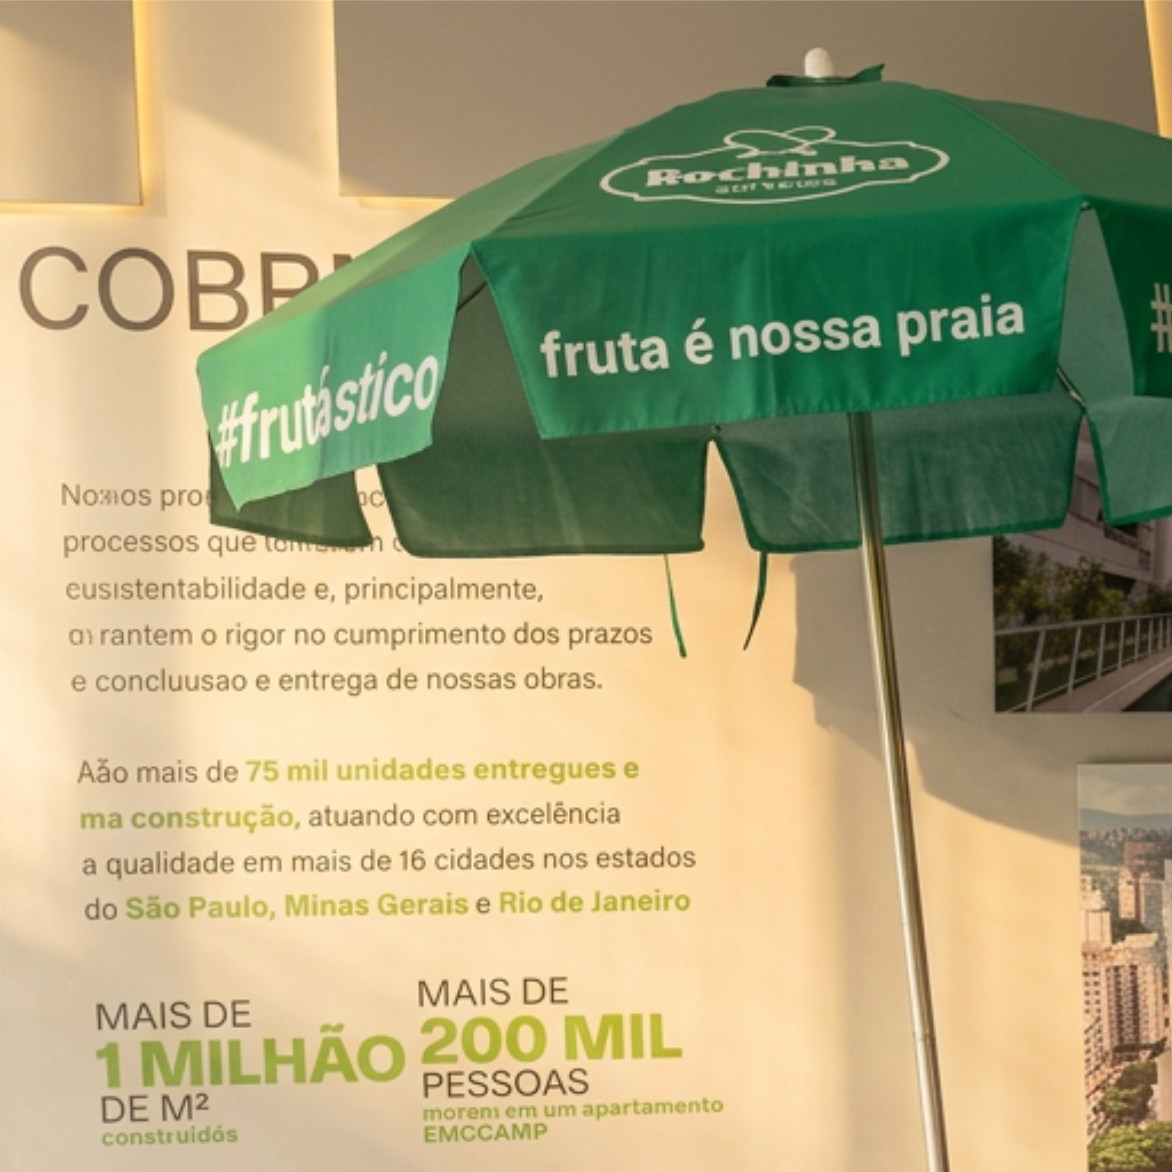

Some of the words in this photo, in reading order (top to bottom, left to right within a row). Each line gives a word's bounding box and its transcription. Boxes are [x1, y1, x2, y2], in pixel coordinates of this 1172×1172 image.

[540, 330, 670, 378] fruta
[684, 318, 715, 364] é
[729, 315, 882, 360] nossa
[896, 294, 1026, 357] praia
[215, 350, 439, 468] #frutástico
[63, 534, 200, 559] processos
[207, 534, 258, 559] que
[313, 582, 336, 603] e,
[344, 575, 544, 605] principalmente,
[200, 628, 218, 646] o
[225, 622, 286, 653] rigor
[294, 628, 326, 646] no
[333, 621, 507, 651] cumprimento
[513, 621, 561, 646] dos
[568, 626, 653, 651] prazos
[70, 674, 87, 693] e
[255, 673, 271, 692] e
[278, 669, 378, 697] entrega
[386, 667, 419, 691] de
[426, 671, 517, 690] nossas
[523, 665, 603, 690] obras.
[136, 759, 198, 784] mais
[205, 759, 239, 784] de
[245, 759, 280, 783] 75
[287, 758, 329, 782] mil
[336, 757, 467, 782] unidades
[473, 758, 617, 786] entregues
[622, 761, 640, 779] e
[80, 811, 124, 830] ma
[130, 804, 301, 835] construção,
[308, 802, 416, 828] atuando
[422, 808, 478, 827] com
[81, 857, 97, 876] a
[105, 850, 235, 881] qualidade
[243, 855, 283, 874] em
[291, 849, 352, 873] mais
[360, 848, 393, 873] de
[399, 848, 427, 872] 16
[434, 846, 535, 871] cidades
[543, 851, 589, 870] nos
[596, 845, 697, 869] estados
[84, 897, 118, 921] do
[125, 895, 181, 921] São
[187, 894, 276, 921] Paulo,
[284, 893, 370, 917] Minas
[376, 891, 470, 917] Gerais
[475, 896, 491, 915] e
[499, 891, 544, 914] Rio
[549, 890, 585, 914] de
[590, 887, 692, 913] Janeiro
[417, 977, 511, 1008] MAIS
[522, 976, 569, 1005] DE
[95, 1000, 192, 1031] MAIS
[203, 999, 252, 1029] DE
[95, 1041, 122, 1090] 1
[137, 1019, 406, 1088] MILHÃO
[420, 1014, 547, 1065] 200
[563, 1012, 683, 1061] MIL
[422, 1067, 589, 1099] PESSOAS
[100, 1094, 150, 1124] DE
[504, 1104, 538, 1119] em
[543, 1104, 577, 1118] um
[582, 1097, 725, 1121] apartamento
[423, 1122, 549, 1144] EMCCAMP
